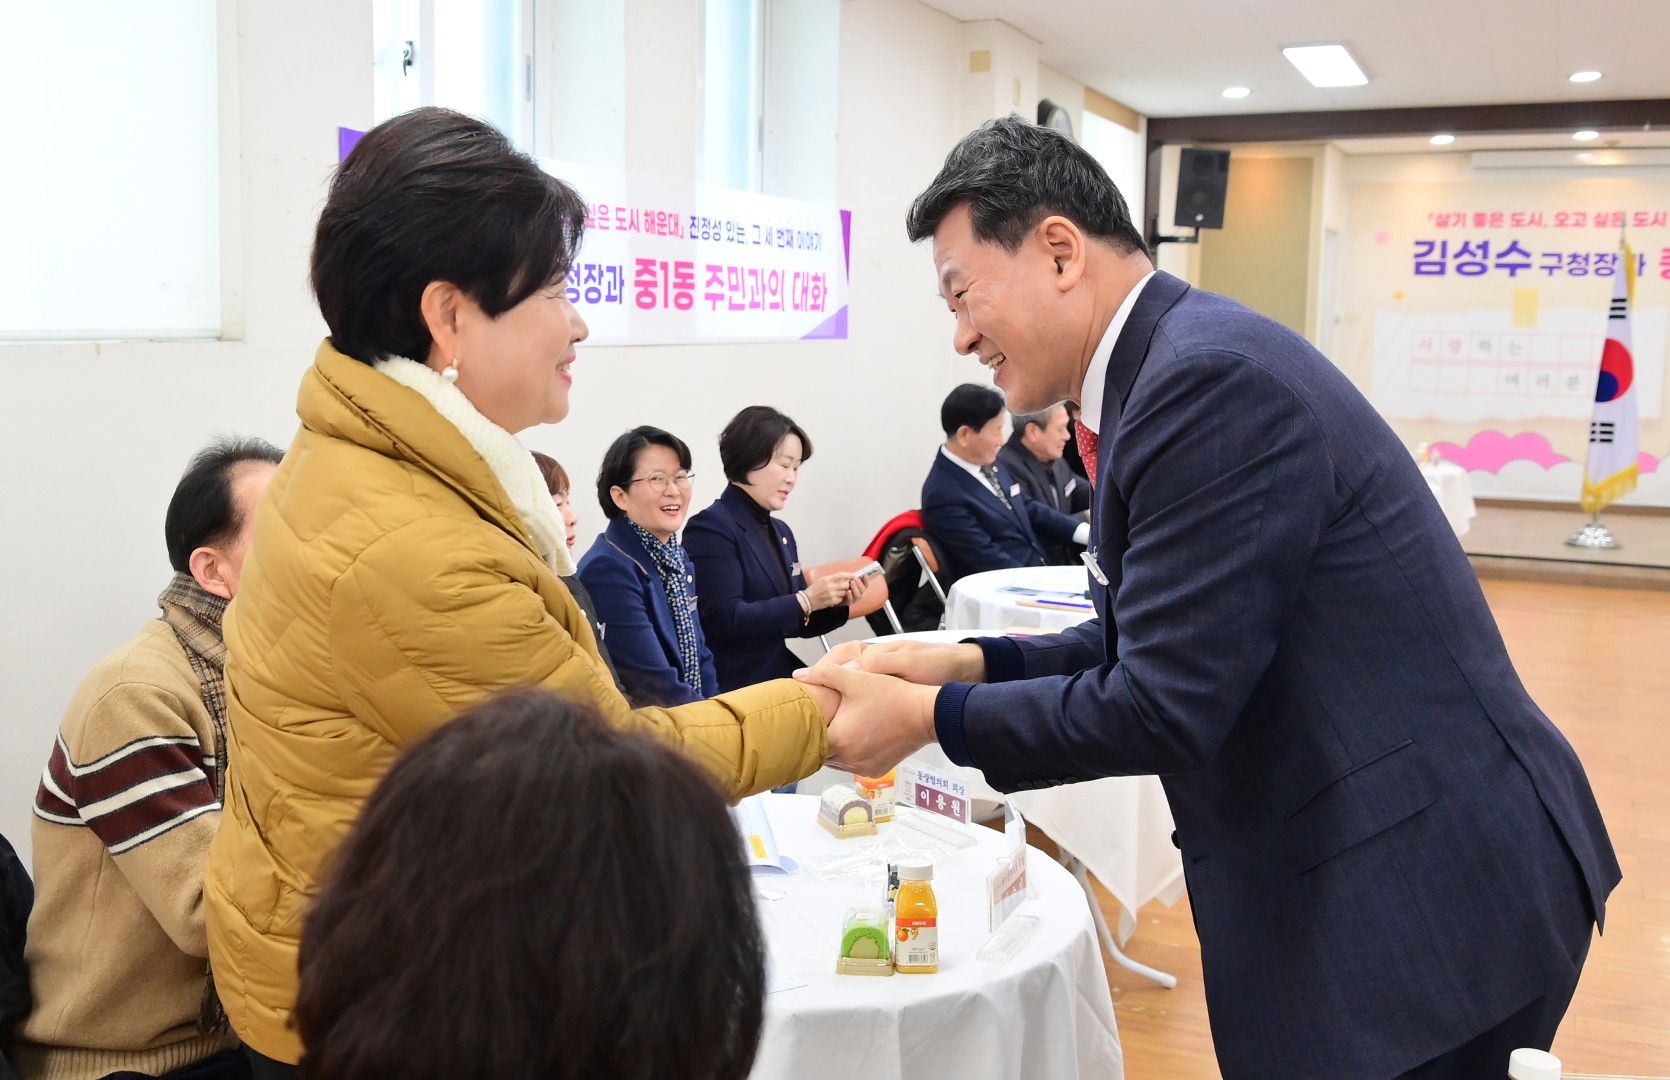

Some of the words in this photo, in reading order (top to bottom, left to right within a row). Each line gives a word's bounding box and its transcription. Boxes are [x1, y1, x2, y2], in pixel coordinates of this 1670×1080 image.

[615, 206, 640, 233] 도시
[643, 209, 684, 239] 해운대」
[690, 216, 722, 242] 진정성
[726, 220, 749, 246] 있는,
[752, 224, 761, 245] 그
[765, 226, 774, 247] 세
[777, 228, 794, 249] 번째
[797, 230, 822, 252] 이야기
[1554, 211, 1588, 228] 오고
[1632, 210, 1667, 228] 도시
[1414, 240, 1532, 277] 김성수
[634, 258, 695, 310] 중1동
[704, 264, 785, 312] 주민과의
[792, 271, 827, 313] 대화
[920, 788, 961, 817] 이용원
